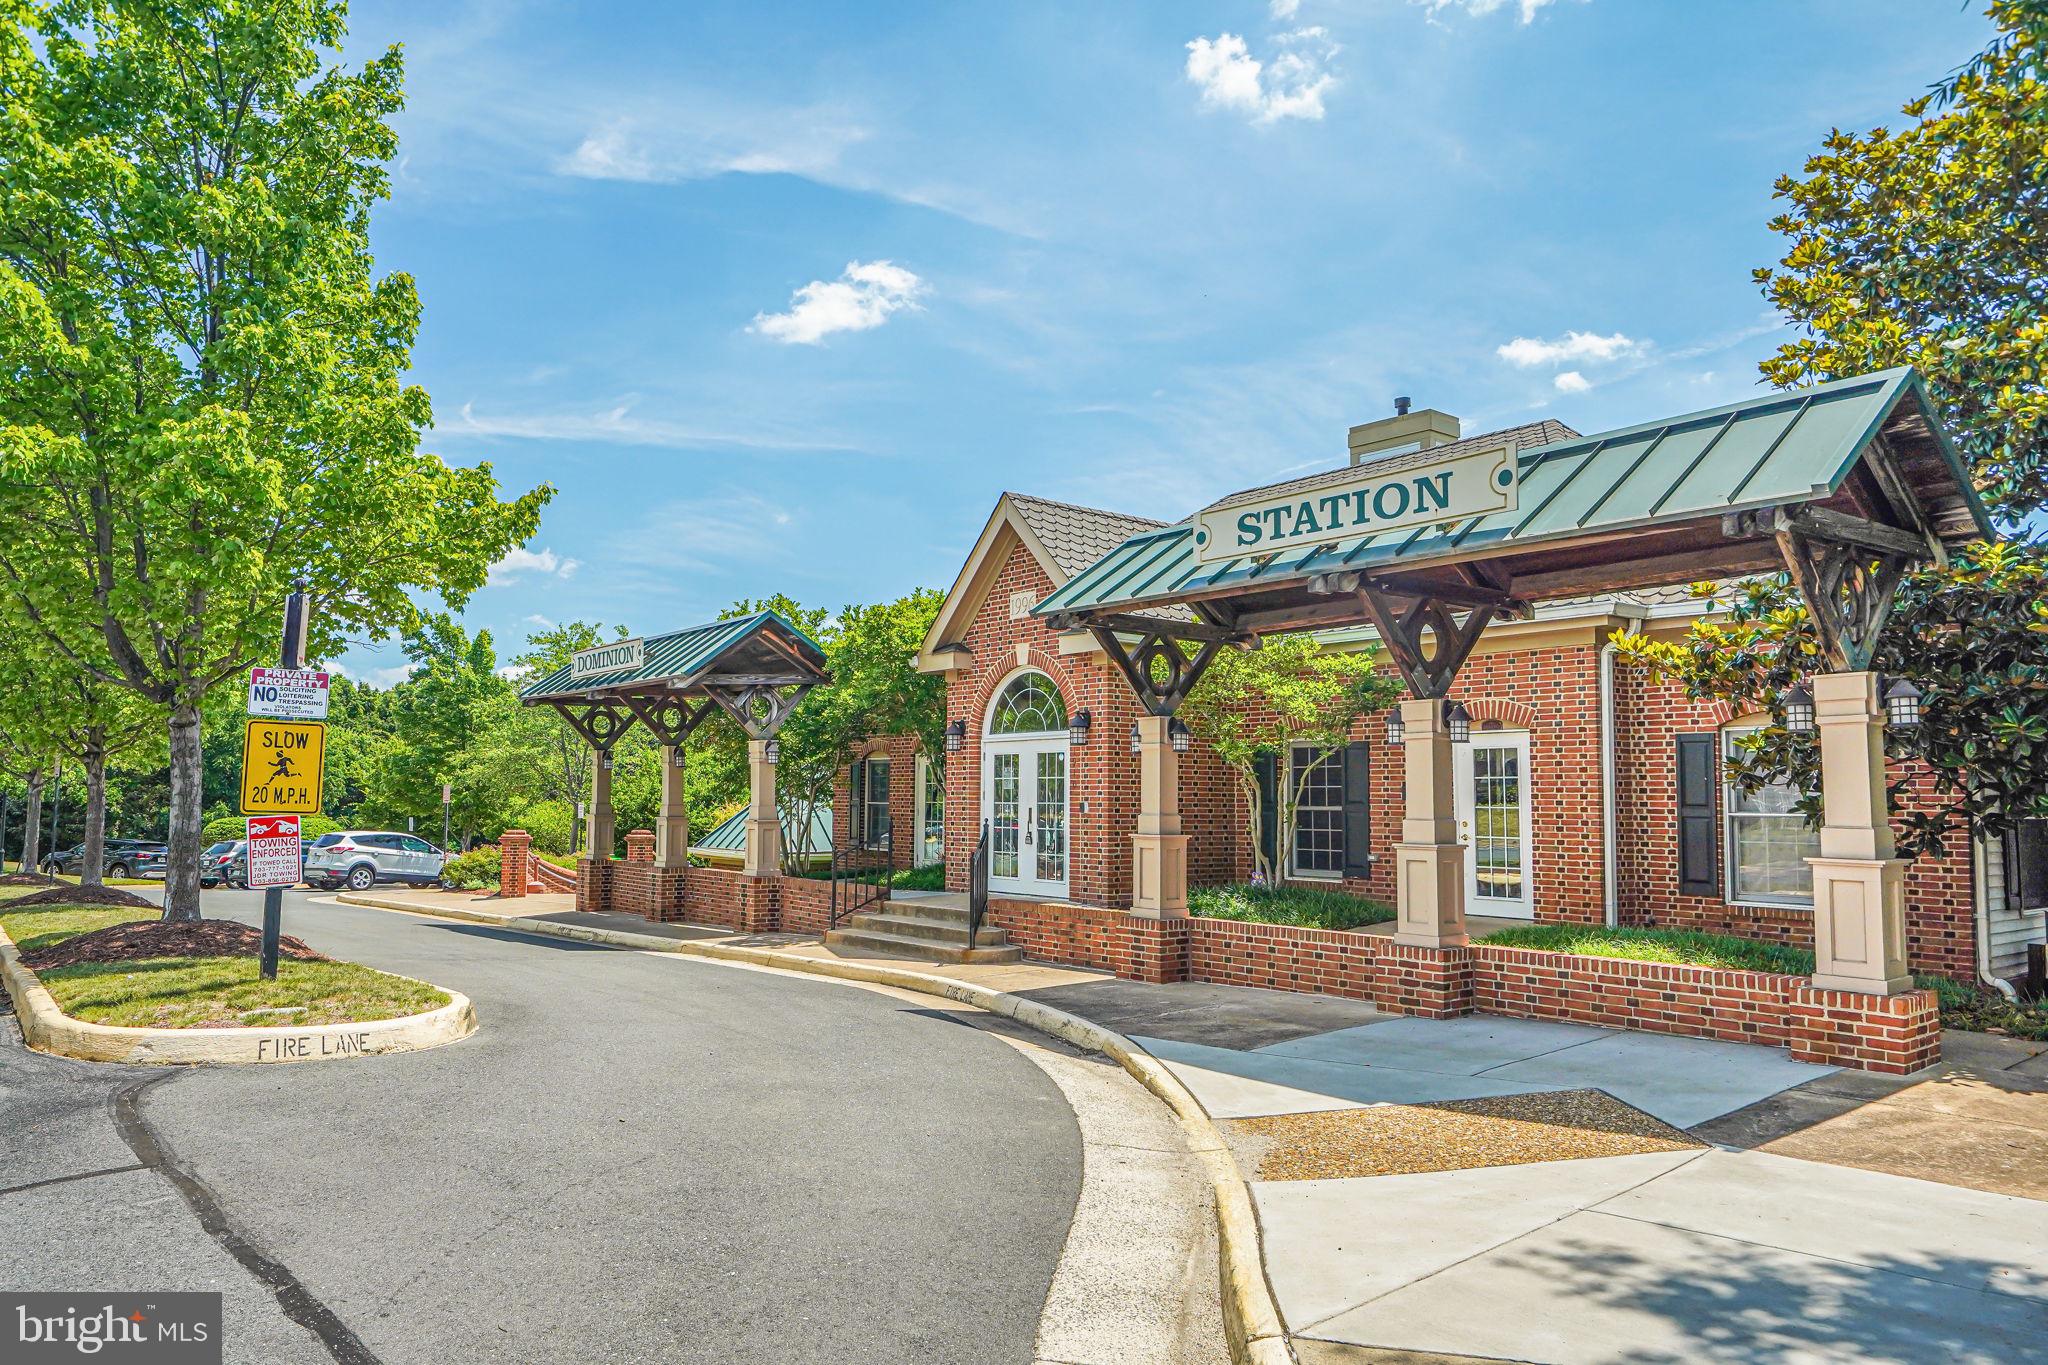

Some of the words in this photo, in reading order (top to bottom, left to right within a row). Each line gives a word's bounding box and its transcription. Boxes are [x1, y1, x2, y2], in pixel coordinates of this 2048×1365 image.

[1237, 471, 1454, 547] STATION
[577, 645, 634, 673] DOMINION
[264, 669, 317, 680] PRIVATE
[256, 676, 324, 688] PROPERTY
[253, 686, 278, 703] NO
[279, 686, 317, 694] SOLICITING
[278, 698, 323, 707] TRESPASSING
[262, 730, 309, 749] SLOW
[252, 786, 268, 803] 20
[273, 787, 311, 804] M.P.H.
[252, 837, 297, 849] TOWING
[252, 847, 297, 859] ENFORCED
[259, 859, 281, 867] TOWED
[270, 870, 298, 878] TOWING
[258, 1037, 312, 1060] FIRE
[321, 1033, 371, 1056] LANE
